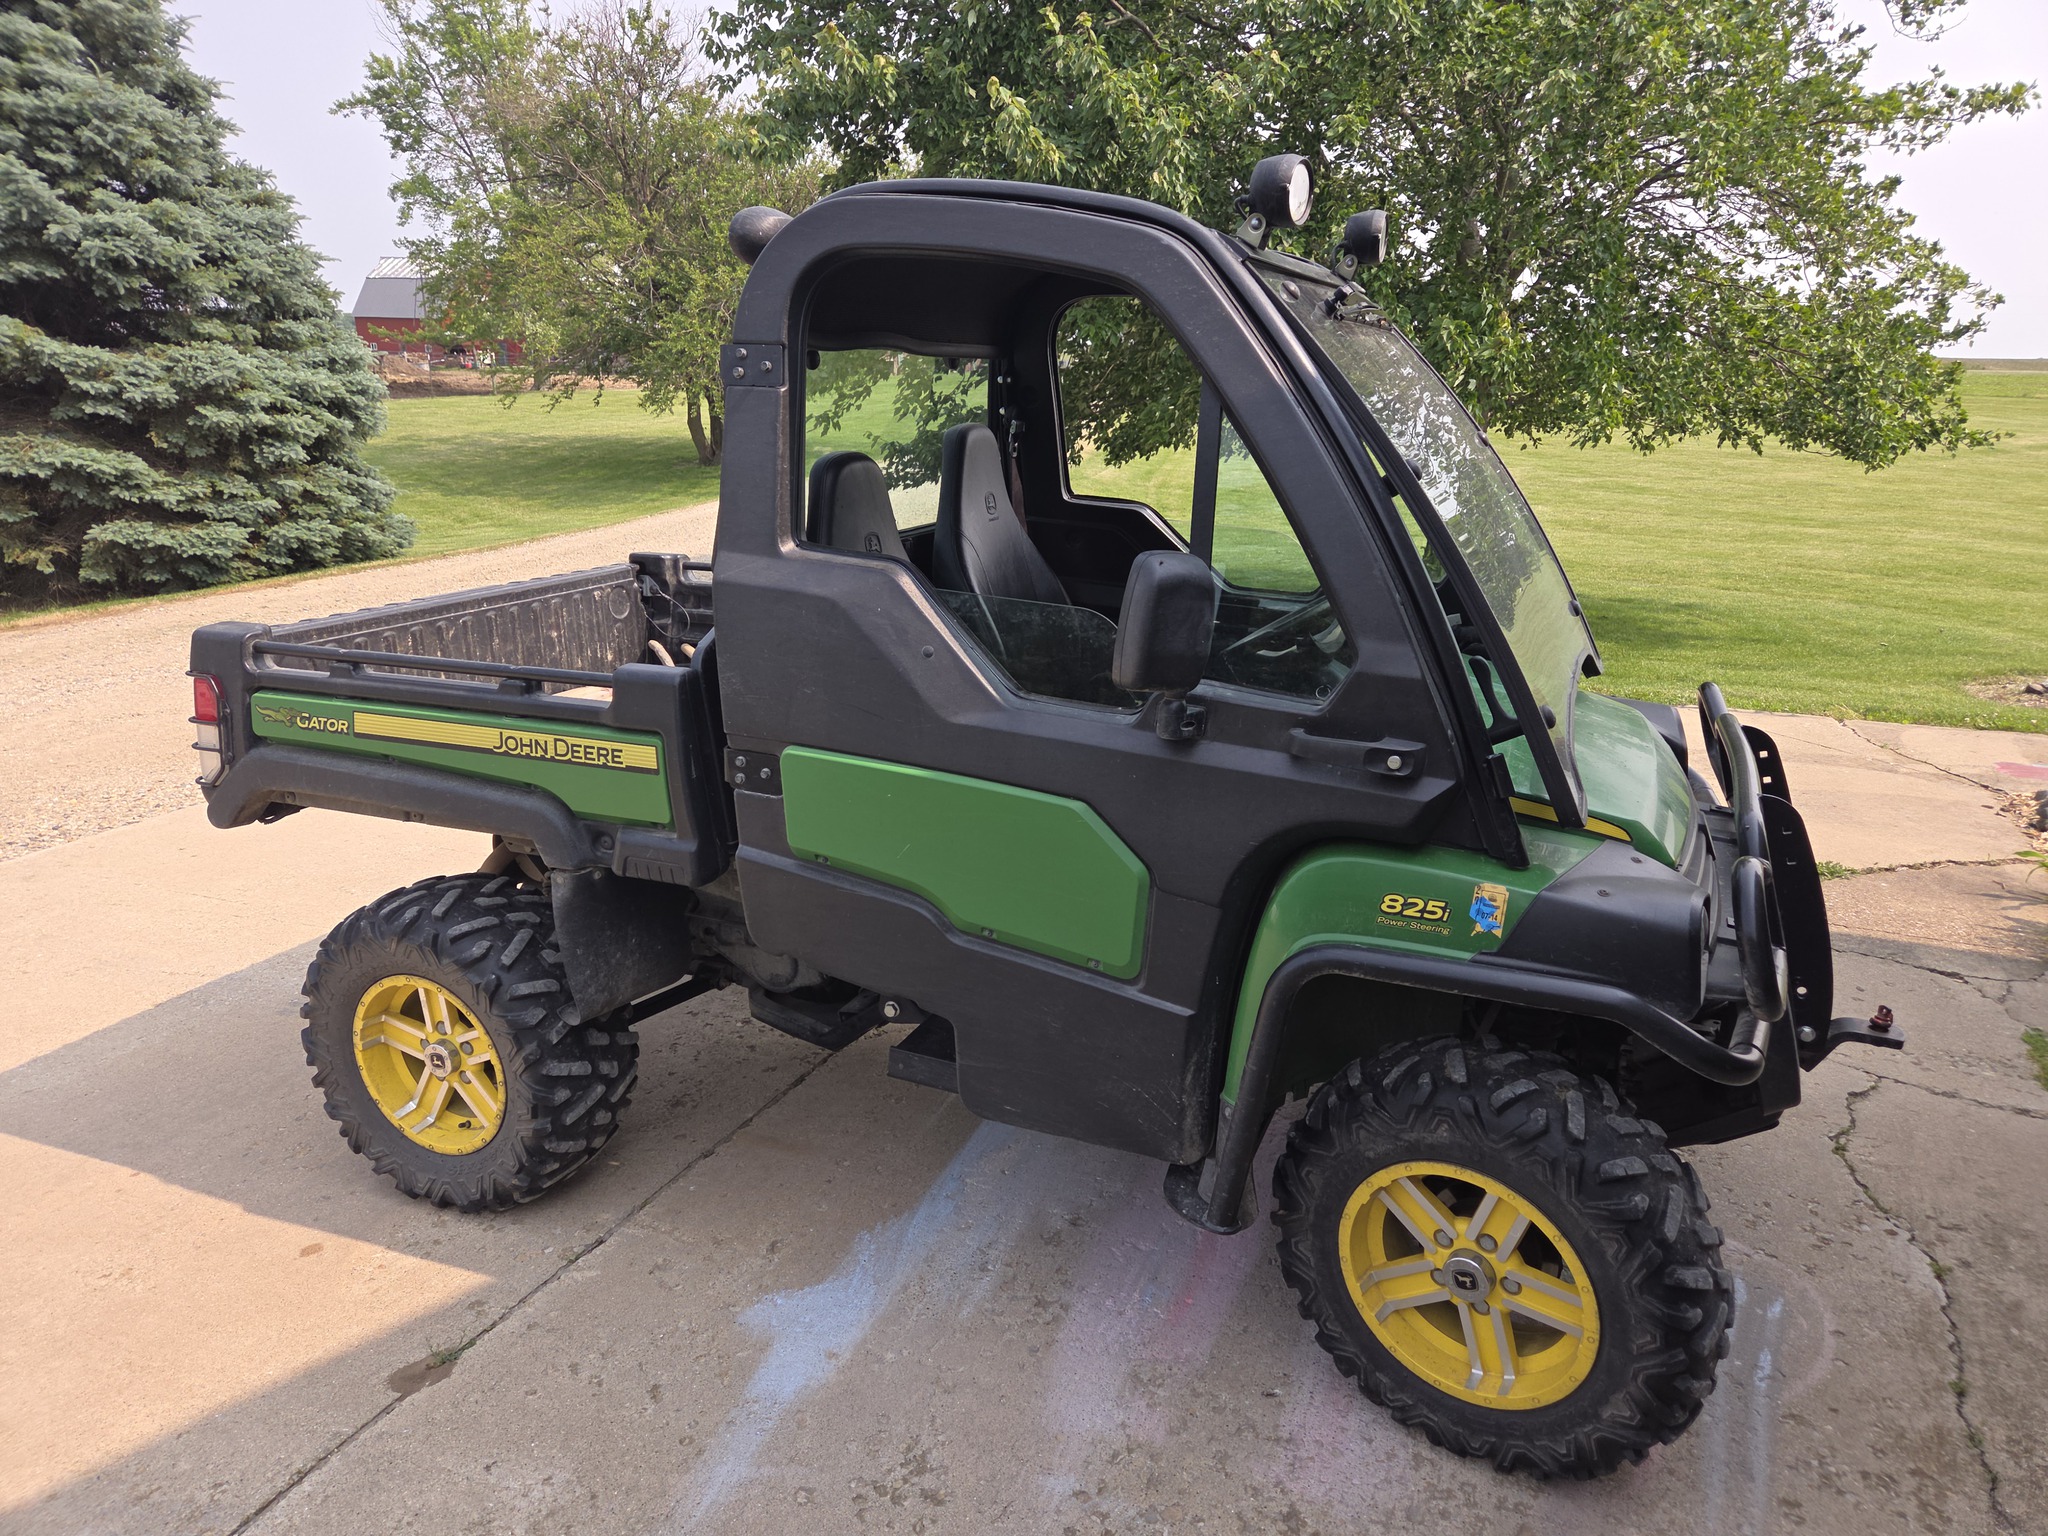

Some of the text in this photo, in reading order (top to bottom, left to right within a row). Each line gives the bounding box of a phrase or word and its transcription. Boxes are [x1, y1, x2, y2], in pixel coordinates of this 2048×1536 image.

[296, 712, 350, 734] GATOR
[493, 731, 624, 765] JOHN DEERE
[1380, 893, 1451, 922] 825i
[1377, 916, 1451, 935] Power Steering
